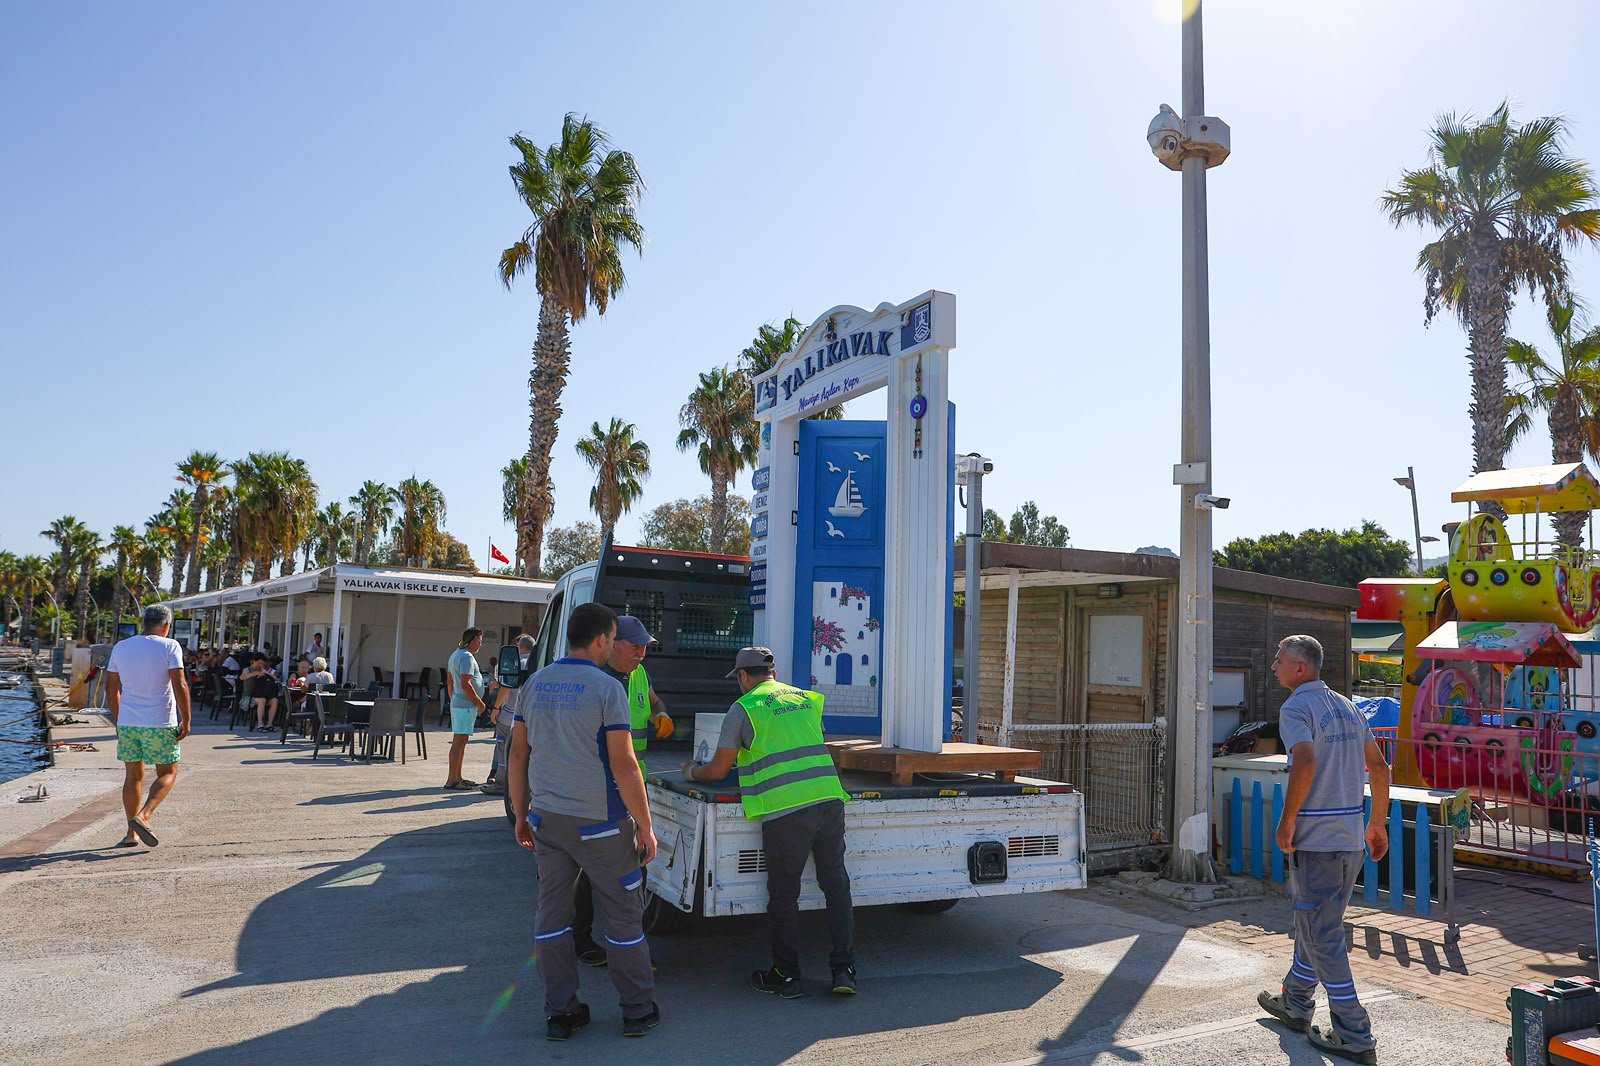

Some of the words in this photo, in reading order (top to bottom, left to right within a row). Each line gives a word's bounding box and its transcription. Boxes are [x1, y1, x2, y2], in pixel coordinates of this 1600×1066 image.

[780, 330, 894, 401] YALIKAVAK
[755, 493, 768, 509] DENİZ
[343, 578, 401, 590] YALIKAVAK
[403, 581, 439, 592] İSKELE
[440, 585, 466, 594] CAFE
[534, 681, 586, 695] BODRUM
